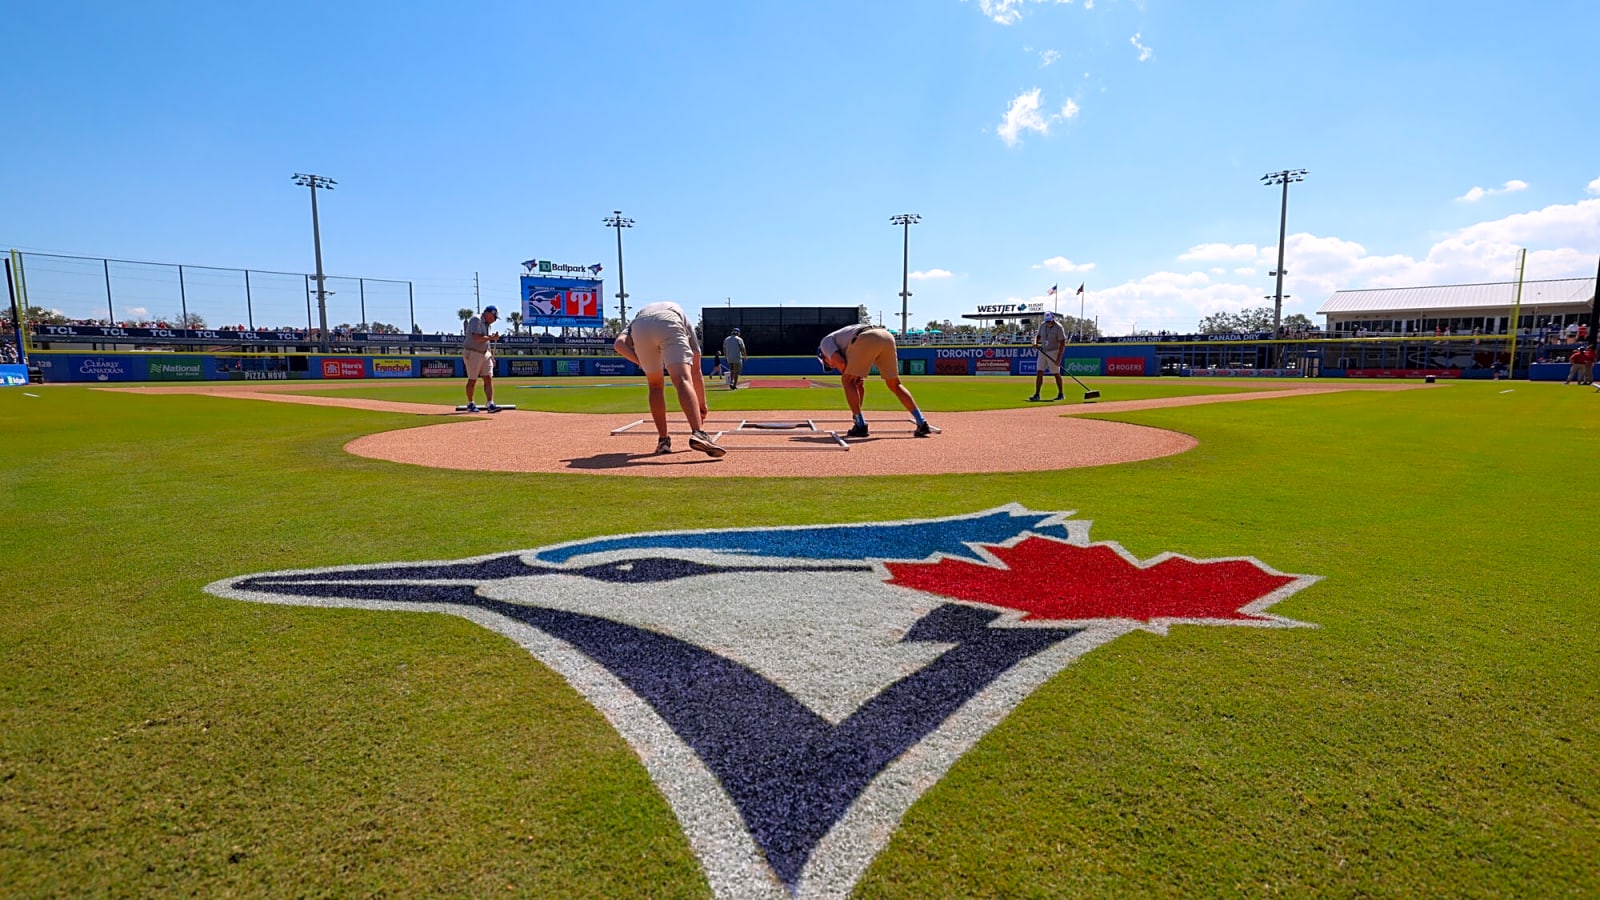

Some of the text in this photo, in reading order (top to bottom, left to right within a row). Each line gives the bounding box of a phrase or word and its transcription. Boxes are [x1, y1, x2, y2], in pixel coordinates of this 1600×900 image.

[542, 263, 586, 272] TD Ballpark
[977, 304, 1016, 313] WESTJET
[47, 326, 77, 335] TCL
[101, 328, 128, 336] TCL
[150, 329, 176, 337] TCL
[936, 349, 1038, 358] TORONTO BLUE JAY
[162, 364, 200, 372] National
[375, 363, 411, 372] Frenchy's
[913, 363, 923, 372] TD
[245, 371, 287, 379] PIZZA NOVA
